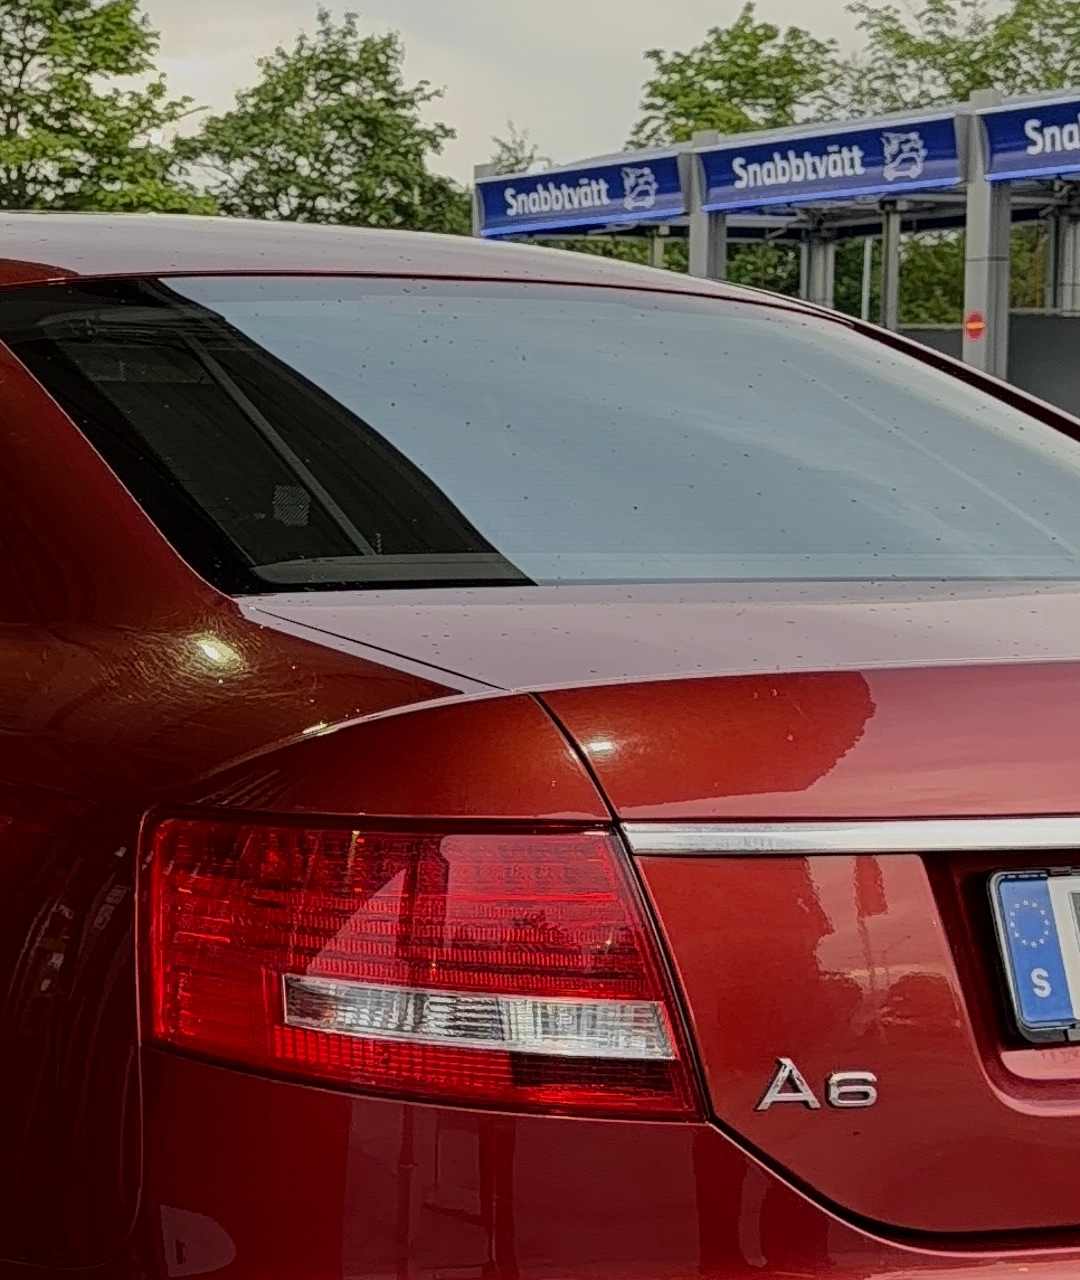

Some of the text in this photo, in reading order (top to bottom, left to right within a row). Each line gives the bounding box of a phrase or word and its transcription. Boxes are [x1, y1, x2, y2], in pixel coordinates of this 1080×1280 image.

[1024, 111, 1080, 155] Sna
[732, 144, 866, 188] Snabbtvätt
[504, 178, 611, 216] Snabbtvätt
[1030, 967, 1052, 998] S
[755, 1056, 878, 1111] A6
